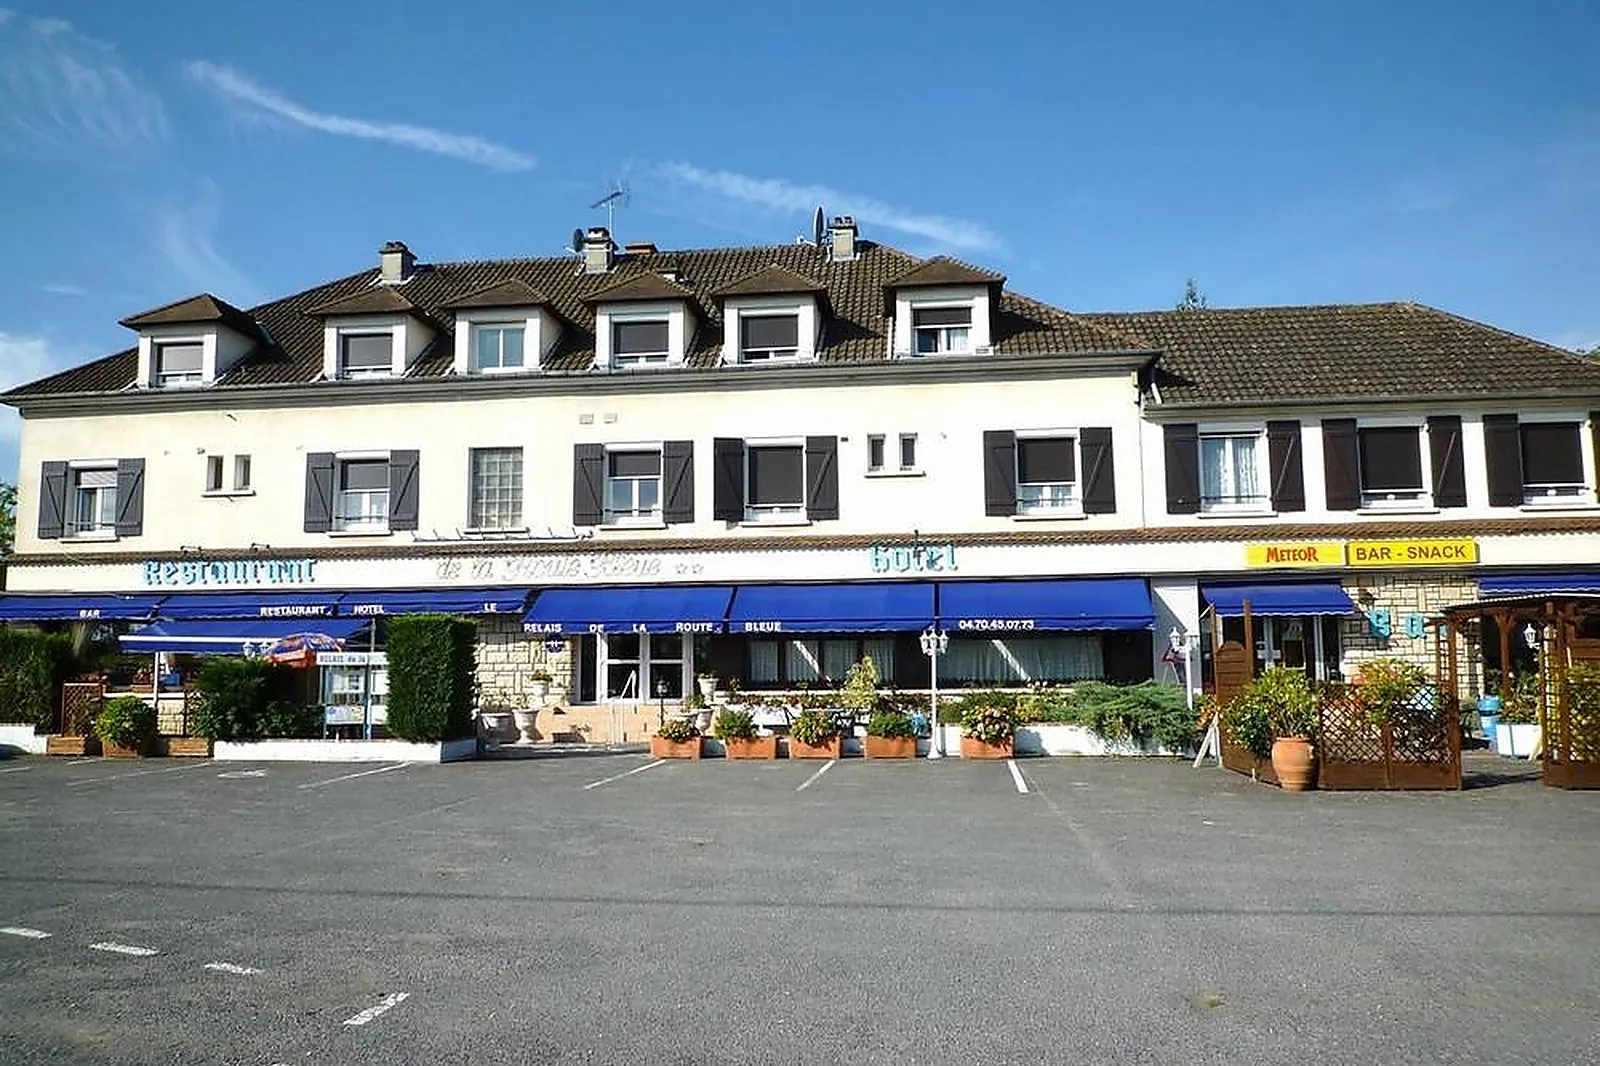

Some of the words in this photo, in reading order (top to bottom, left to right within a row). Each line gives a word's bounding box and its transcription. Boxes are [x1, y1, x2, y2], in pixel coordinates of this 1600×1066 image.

[1267, 547, 1319, 562] METEOR
[1357, 548, 1391, 560] BAR
[1408, 546, 1466, 558] SNACK
[144, 560, 317, 585] Restaurant
[260, 606, 326, 617] RESTAURANT
[354, 605, 384, 614] HOTEL
[484, 603, 497, 612] LE
[80, 609, 101, 618] BAR
[524, 623, 562, 632] RELAIS
[589, 624, 604, 633] DE
[632, 624, 647, 632] LA
[675, 623, 713, 632] ROUTE
[744, 622, 782, 632] BLEUE
